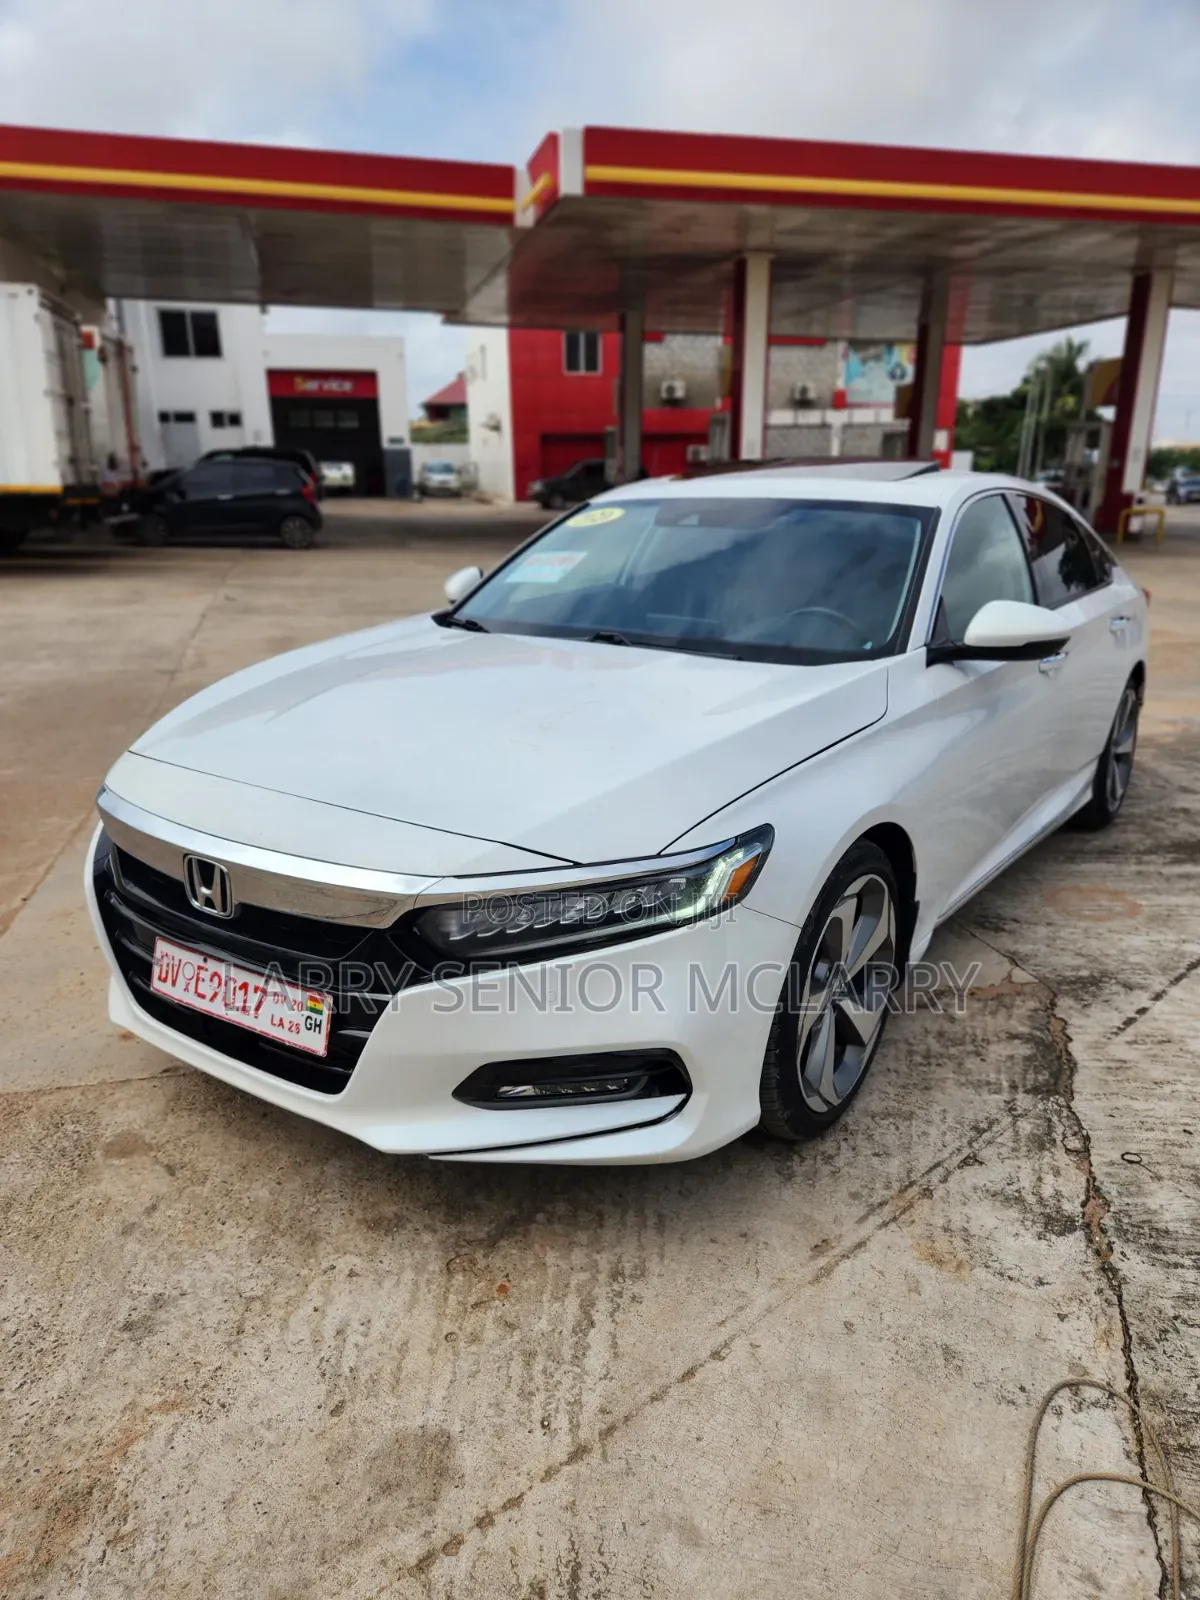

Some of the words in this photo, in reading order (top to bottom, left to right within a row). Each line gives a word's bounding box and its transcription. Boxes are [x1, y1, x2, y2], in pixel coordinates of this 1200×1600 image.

[294, 376, 353, 392] Service
[270, 1013, 285, 1030] LA
[304, 1014, 323, 1035] GH
